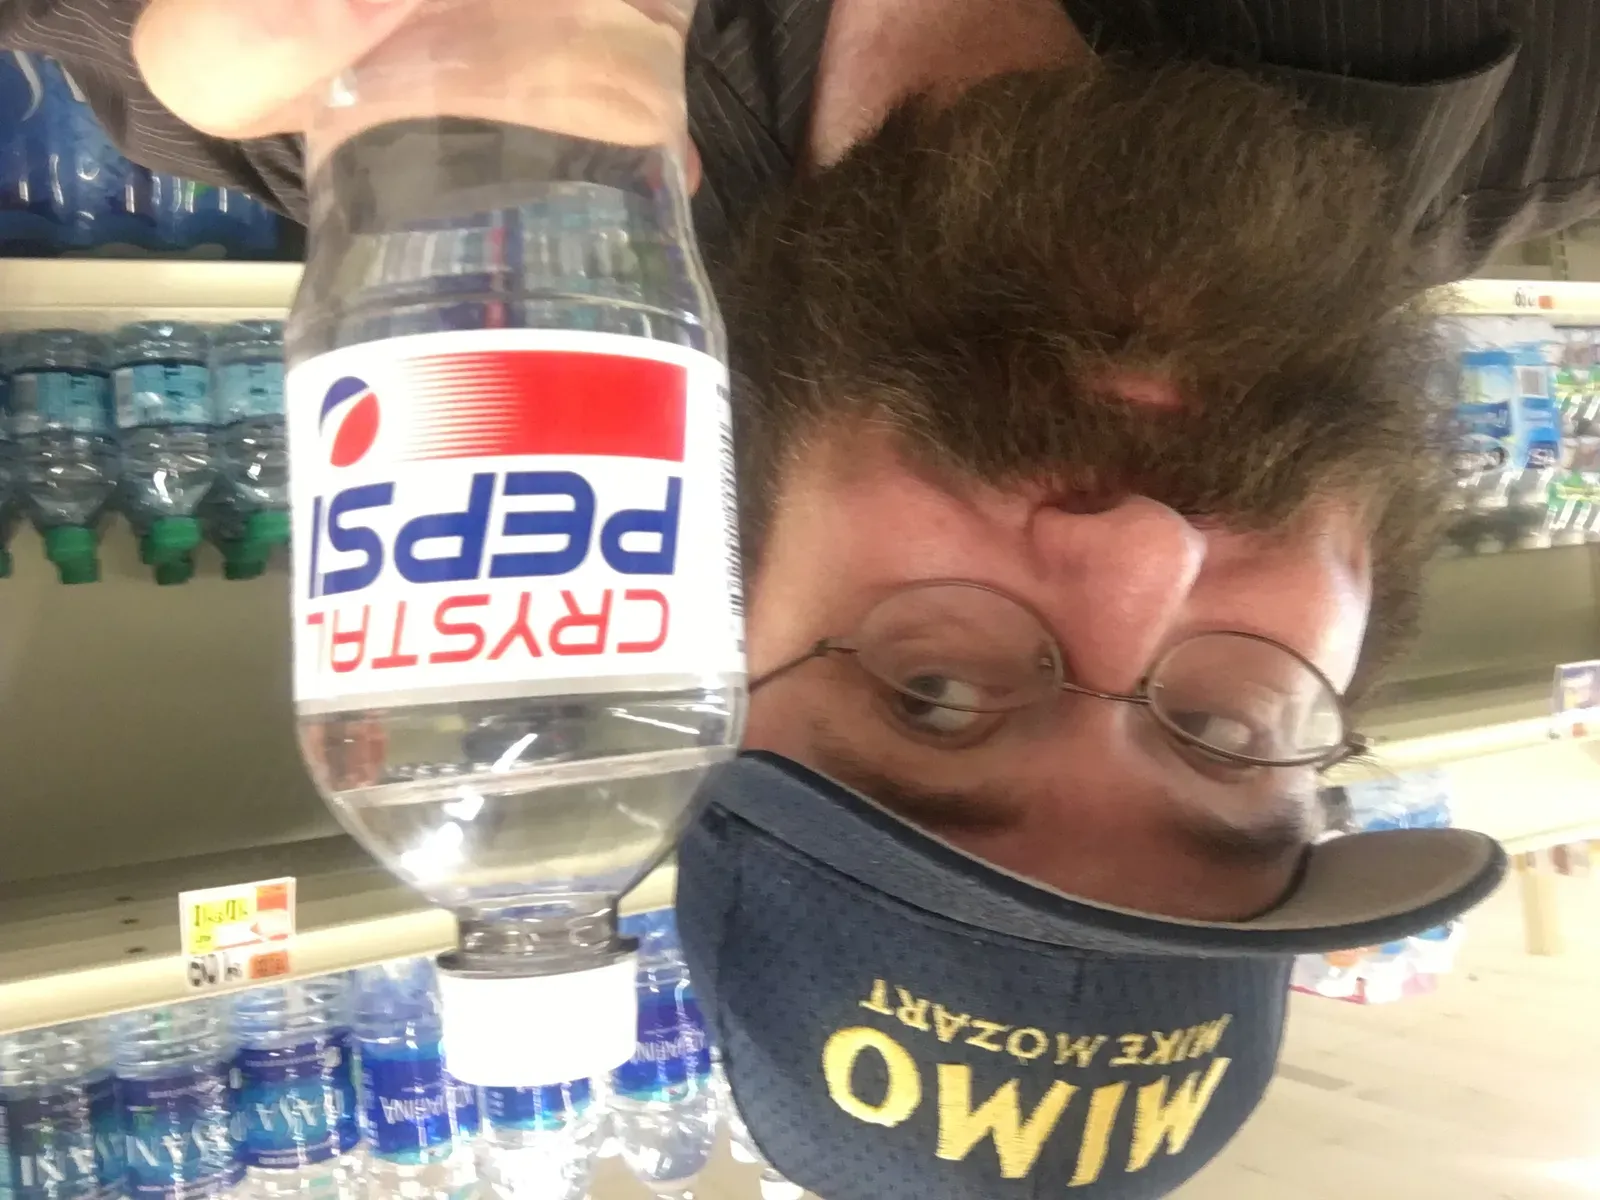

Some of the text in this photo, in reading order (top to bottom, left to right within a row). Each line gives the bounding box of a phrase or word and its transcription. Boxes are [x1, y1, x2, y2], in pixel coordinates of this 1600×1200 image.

[309, 470, 682, 599] PEPSI
[305, 588, 671, 674] CRYSTAL
[858, 977, 1234, 1069] MIKE MOZART
[821, 1026, 1233, 1188] MIMO
